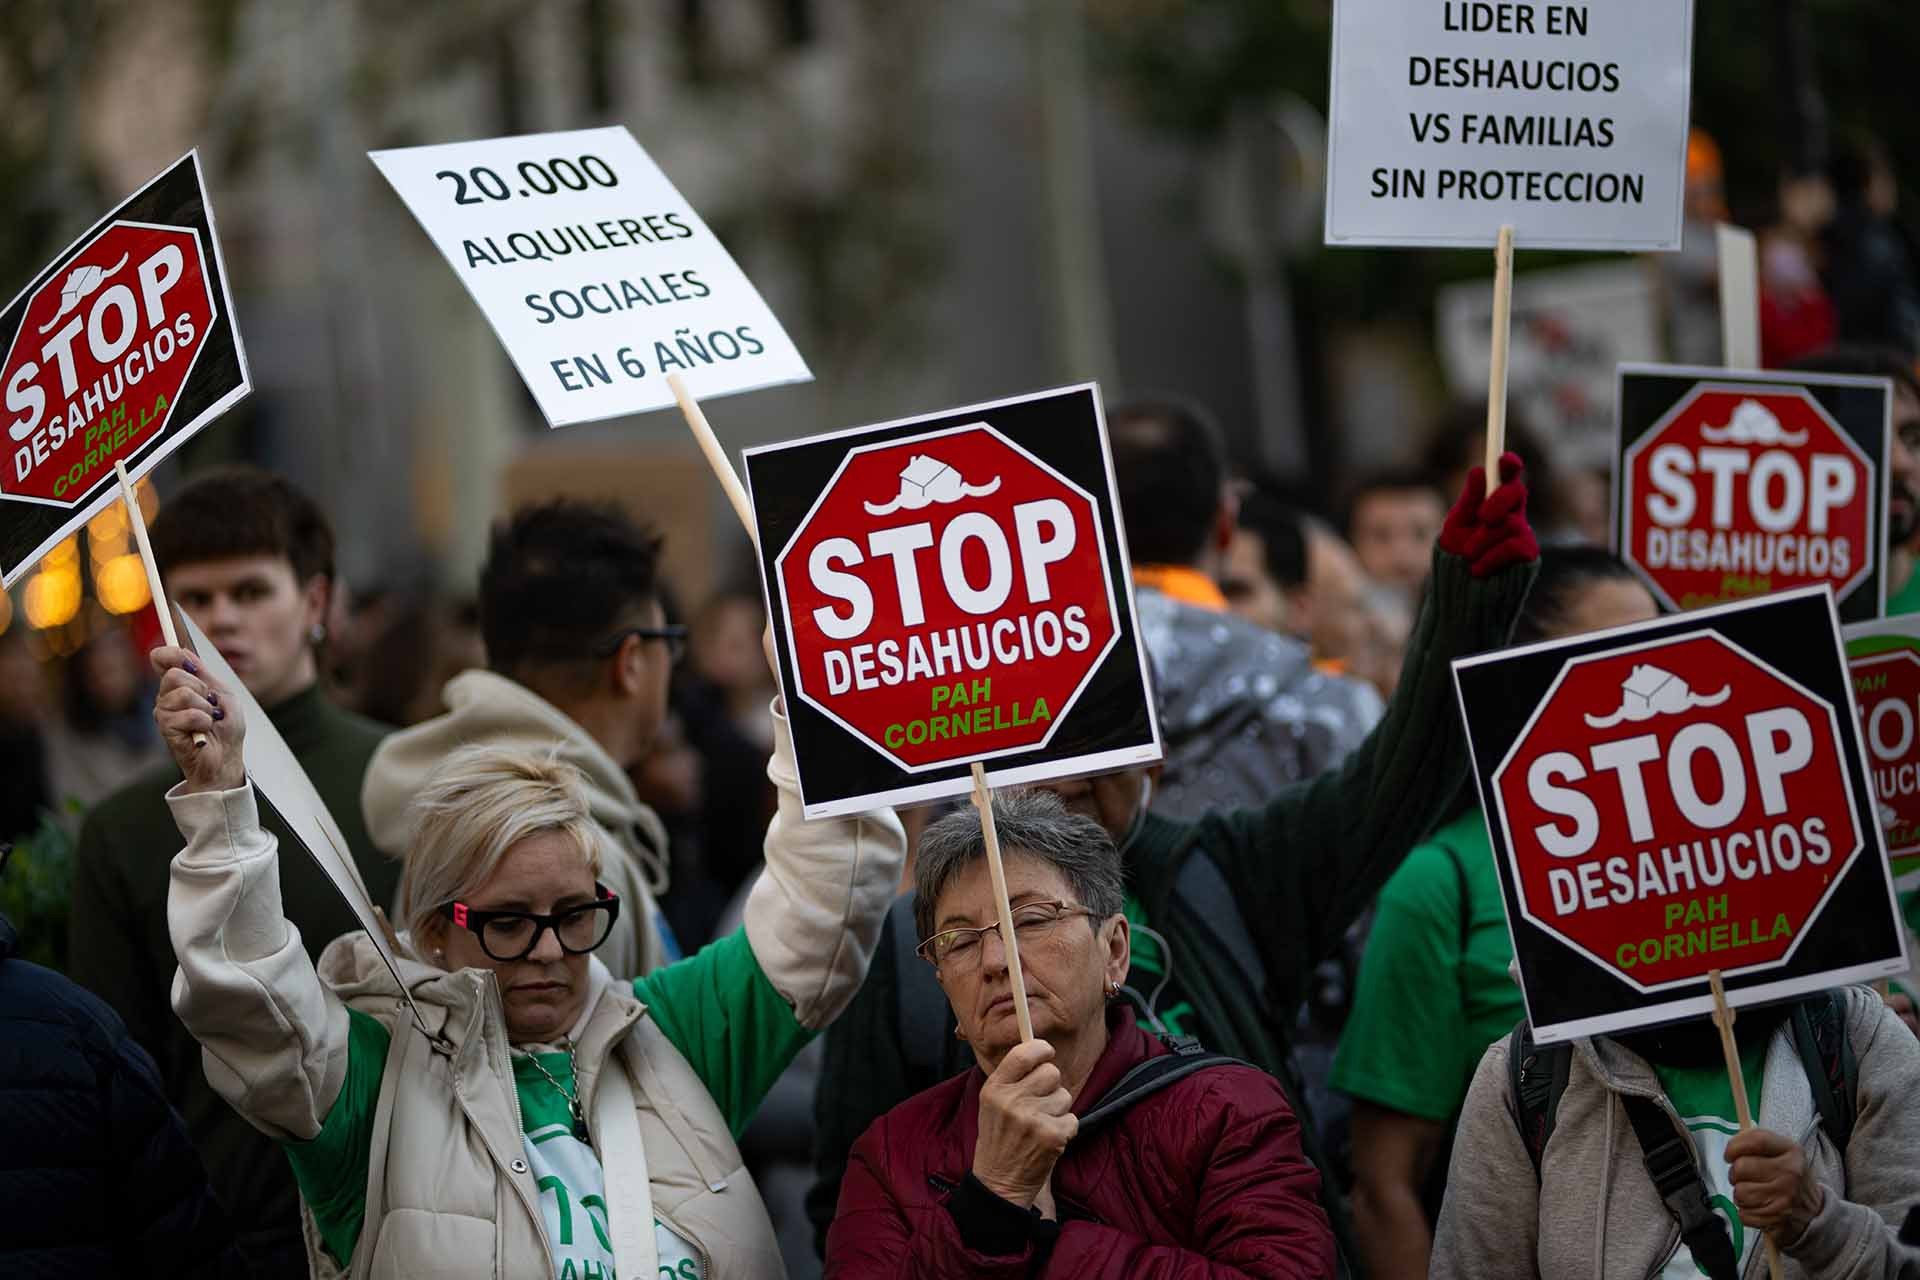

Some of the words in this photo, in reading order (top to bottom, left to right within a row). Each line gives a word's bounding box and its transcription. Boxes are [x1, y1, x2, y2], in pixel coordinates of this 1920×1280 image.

[1444, 1, 1535, 34] LIDER
[1546, 6, 1588, 36] EN
[1408, 56, 1620, 92] DESHAUCIOS
[1409, 113, 1450, 143] VS
[1462, 114, 1615, 147] FAMILIAS
[436, 155, 618, 205] 20.000
[1371, 168, 1425, 198] SIN
[1438, 170, 1644, 203] PROTECCION
[462, 213, 693, 268] ALQUILERES
[525, 270, 711, 324] SOCIALES
[5, 243, 184, 442] STOP
[550, 354, 613, 392] EN
[617, 347, 646, 379] 6
[654, 326, 765, 373] AÑOS
[14, 312, 195, 483] DESAHUCIOS
[53, 394, 168, 497] CORNELLA
[84, 401, 126, 450] PAH
[1646, 444, 1857, 534] STOP
[808, 498, 1077, 640] STOP
[1646, 528, 1850, 578] DESAHUCIOS
[823, 605, 1090, 696] DESAHUCIOS
[931, 677, 991, 711] PAH
[884, 697, 1051, 749] CORNELLA
[1527, 706, 1814, 858] STOP
[1548, 817, 1831, 916] DESAHUCIOS
[1665, 894, 1728, 929] PAH
[1616, 913, 1793, 968] CORNELLA
